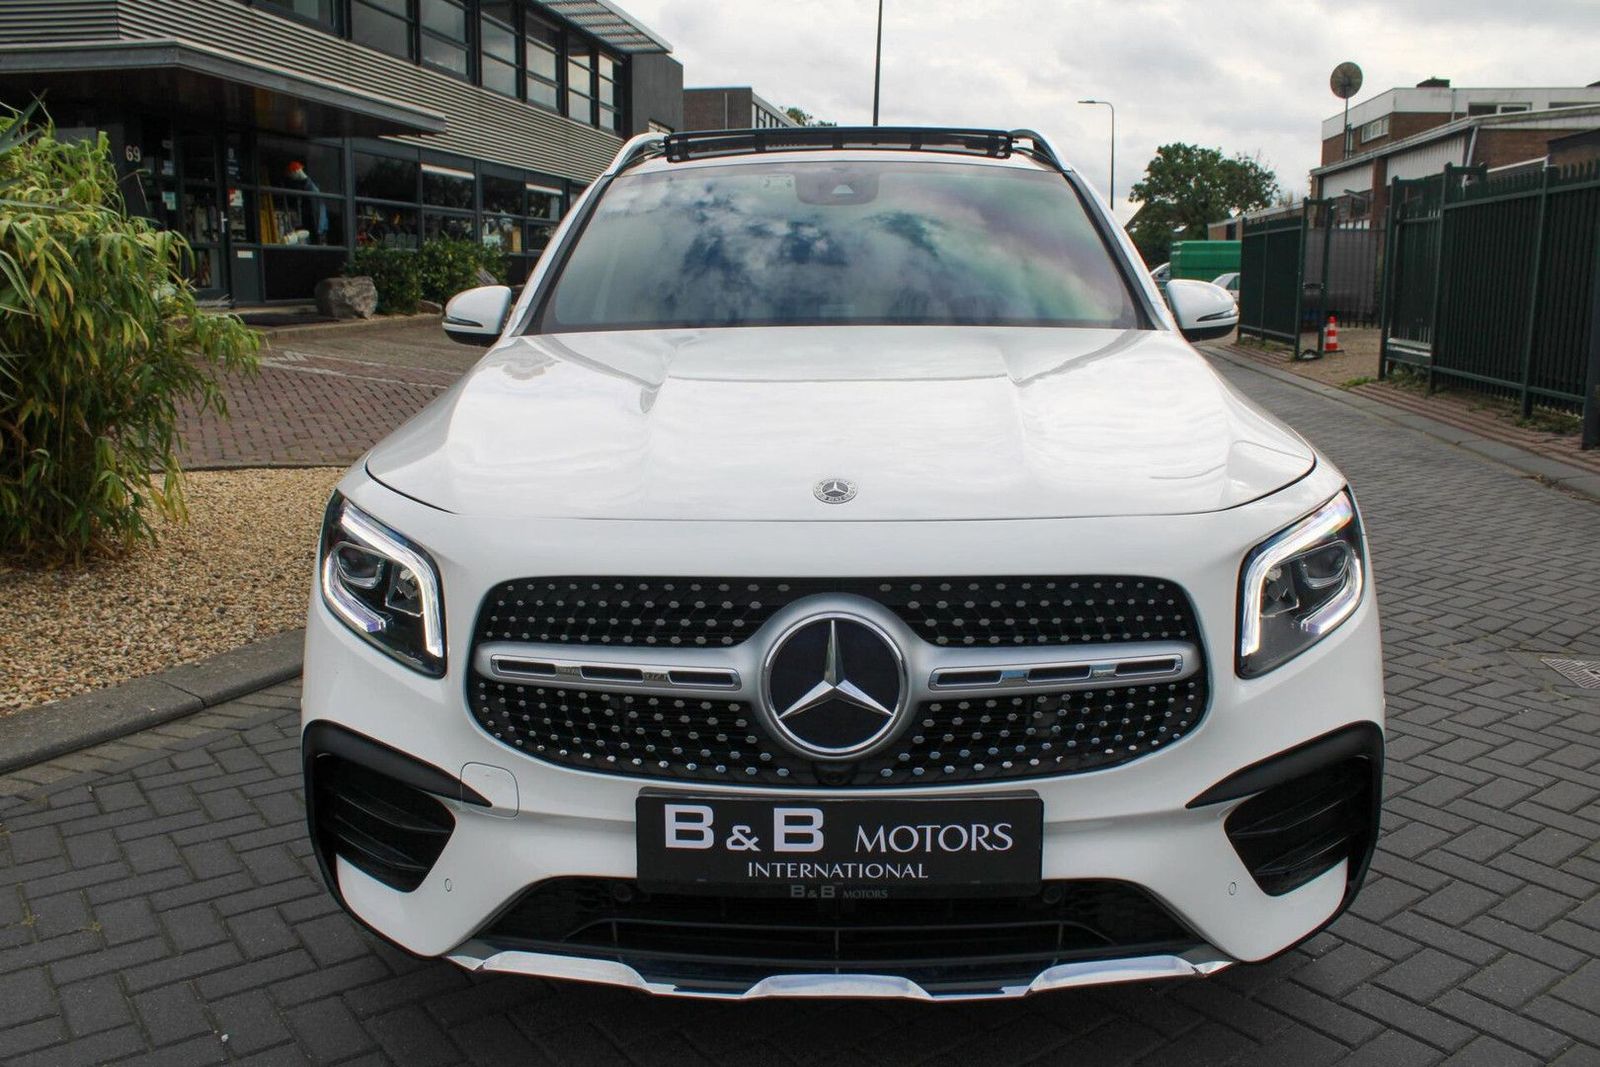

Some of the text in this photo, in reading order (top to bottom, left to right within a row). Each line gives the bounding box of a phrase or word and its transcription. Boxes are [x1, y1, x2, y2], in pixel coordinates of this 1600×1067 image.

[125, 145, 141, 161] 69
[854, 822, 1014, 854] MOTORS
[747, 861, 929, 879] INTERNATIONAL
[843, 888, 888, 899] MOTORS
